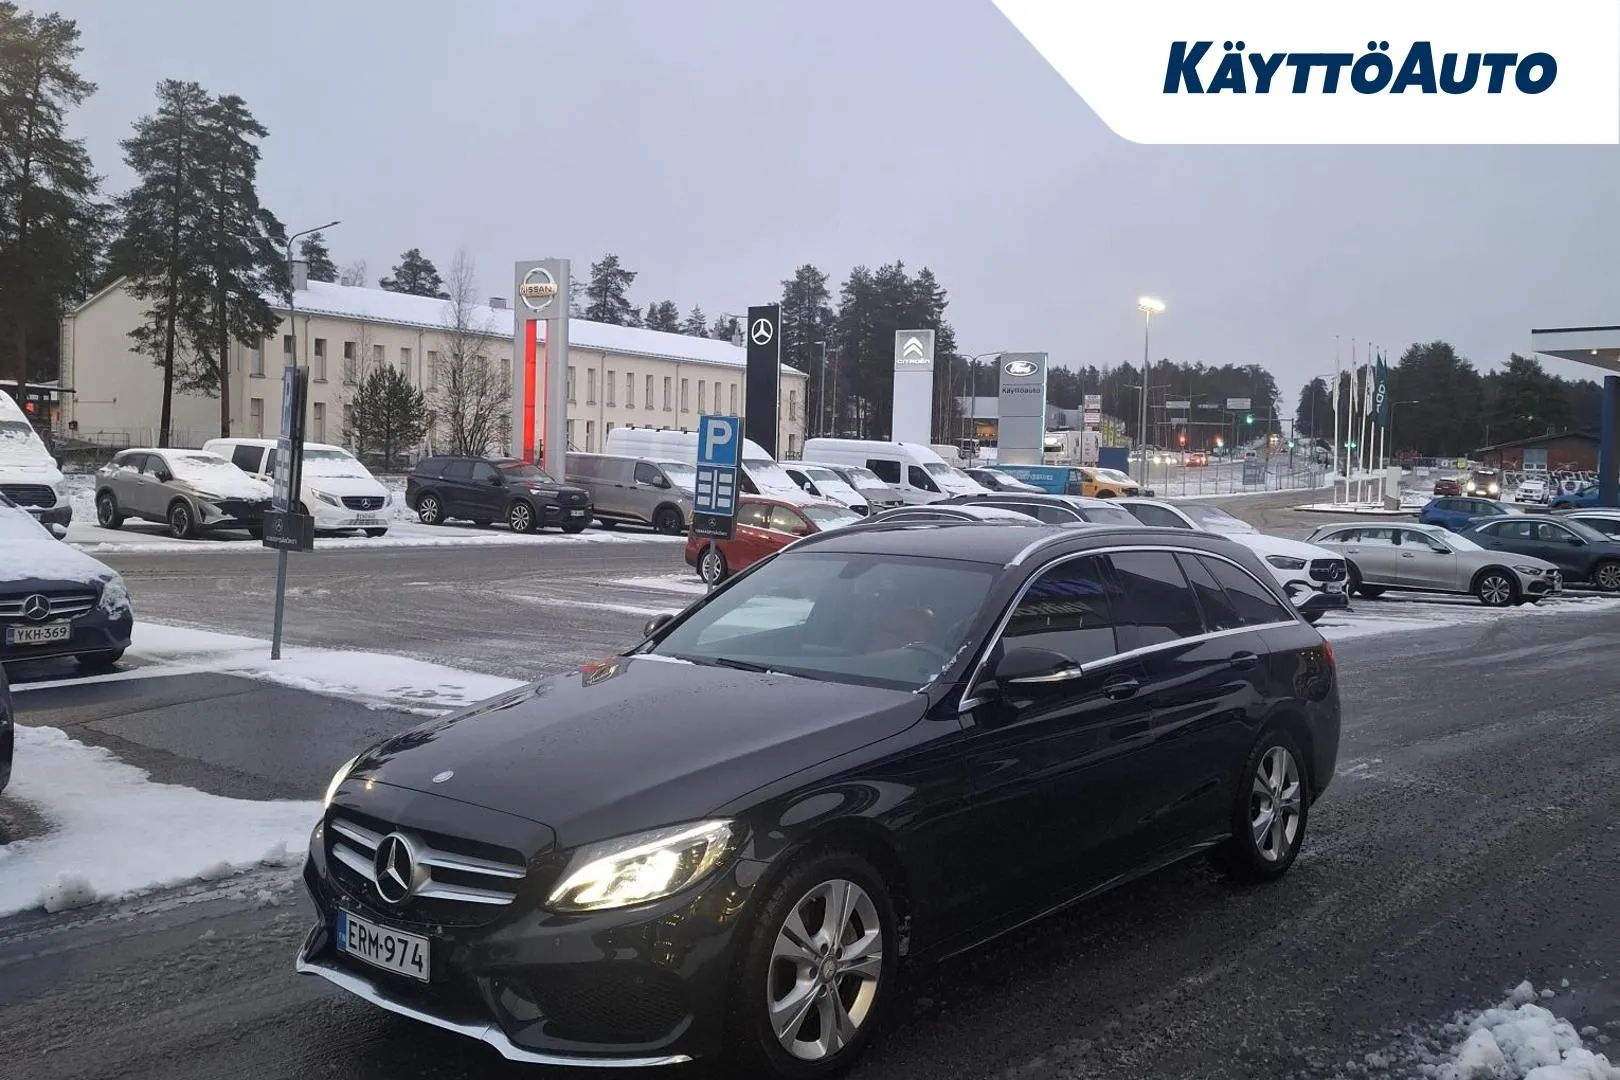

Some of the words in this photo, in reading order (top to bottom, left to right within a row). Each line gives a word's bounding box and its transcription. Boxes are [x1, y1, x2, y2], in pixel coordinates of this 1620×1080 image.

[520, 285, 552, 293] NISSAN
[705, 419, 732, 460] P
[17, 627, 67, 641] YKH-369
[348, 919, 423, 973] ERM-974
